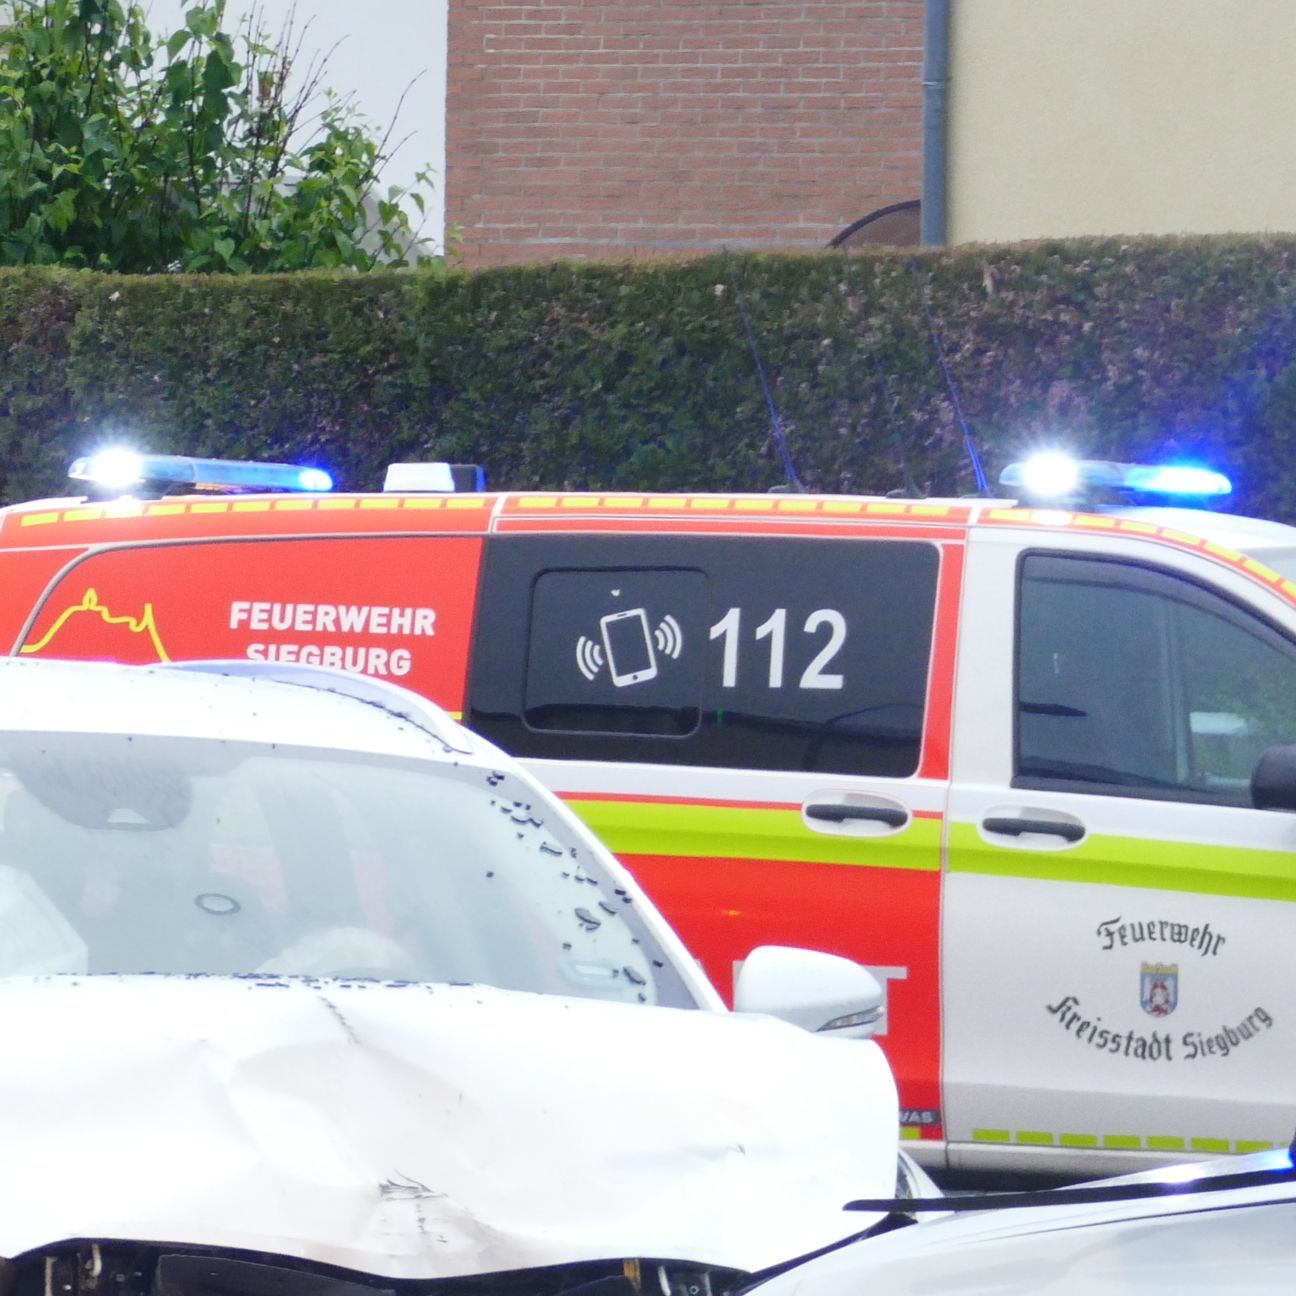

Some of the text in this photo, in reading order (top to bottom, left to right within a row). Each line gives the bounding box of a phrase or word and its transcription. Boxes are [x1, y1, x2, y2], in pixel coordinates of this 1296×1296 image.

[229, 601, 436, 636] FEUERWEHR
[246, 643, 412, 676] SIEGBURG
[709, 607, 847, 690] 112
[1096, 916, 1226, 957] Feuerwehr
[1046, 996, 1274, 1061] Kreisstadt Siegburg
